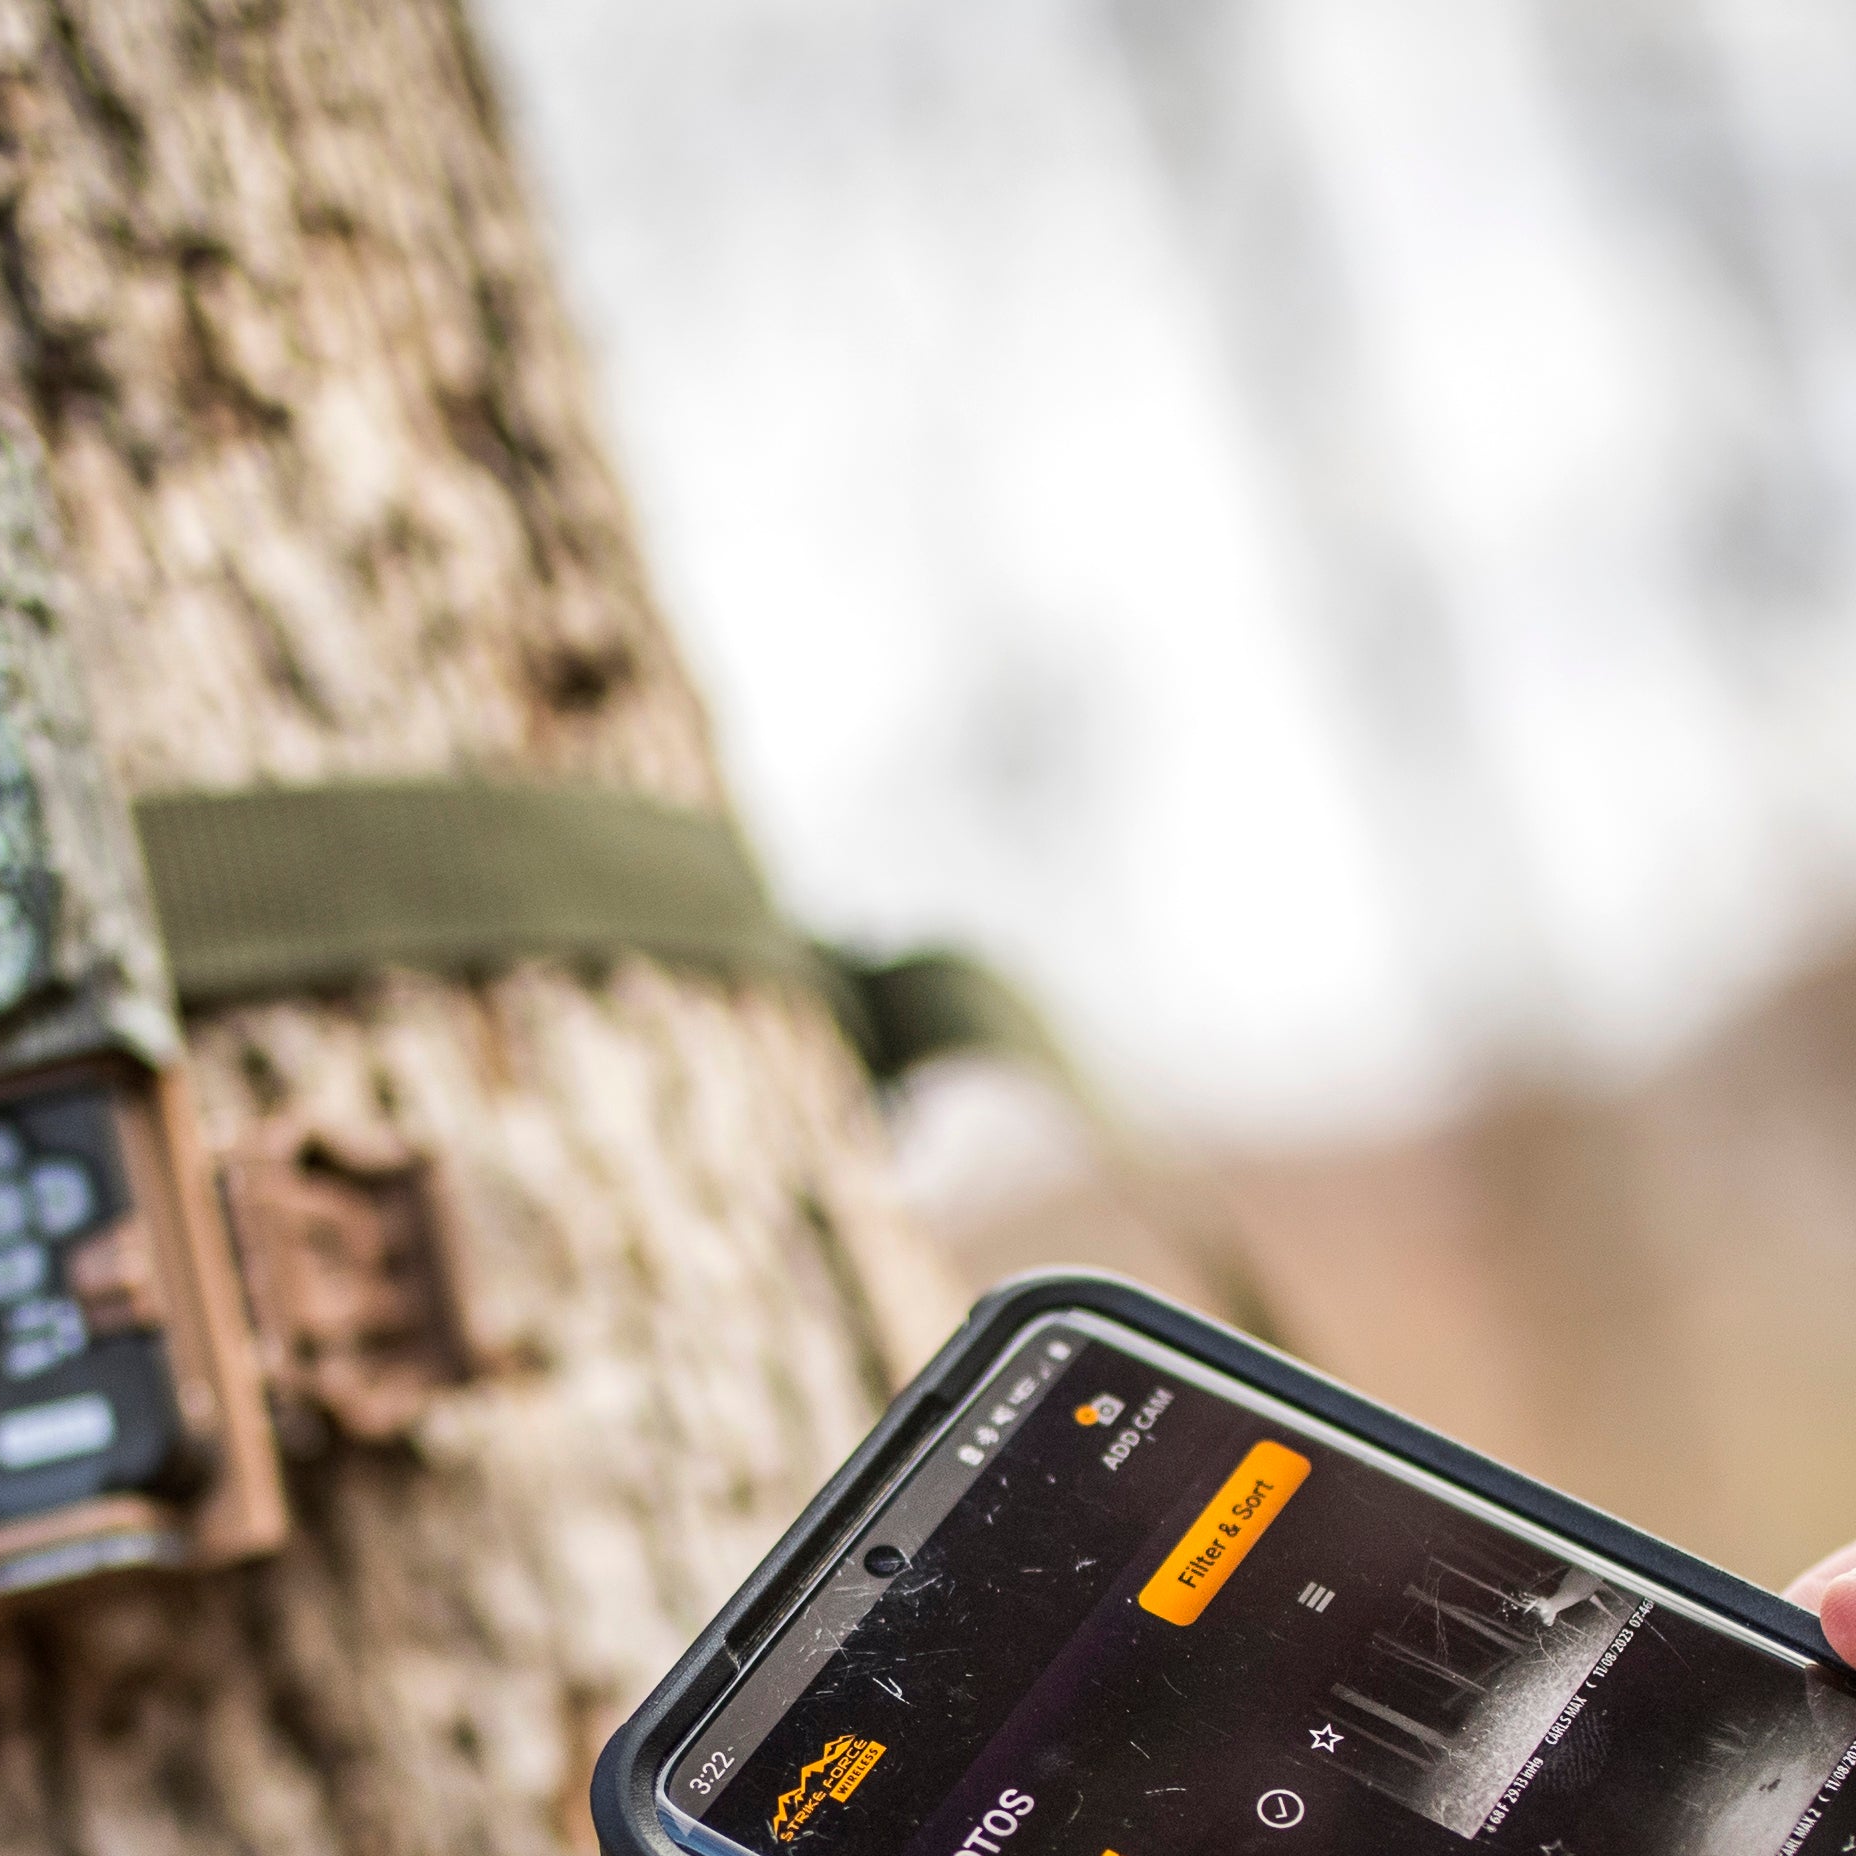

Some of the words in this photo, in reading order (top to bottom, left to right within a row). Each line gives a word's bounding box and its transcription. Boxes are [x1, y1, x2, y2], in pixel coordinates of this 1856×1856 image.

[1101, 1428, 1141, 1472] ADD
[1133, 1387, 1175, 1431] CAM
[1177, 1538, 1226, 1590] Filter
[1218, 1522, 1242, 1540] &
[1231, 1478, 1275, 1521] Sort
[1544, 1715, 1572, 1746] CARLS
[1563, 1694, 1588, 1719] MAX
[1592, 1628, 1635, 1678] 11/08/2023
[688, 1749, 736, 1796] 3:22
[779, 1789, 828, 1843] STRIKE
[822, 1738, 869, 1790] FORCE
[836, 1746, 880, 1797] WIRELESS
